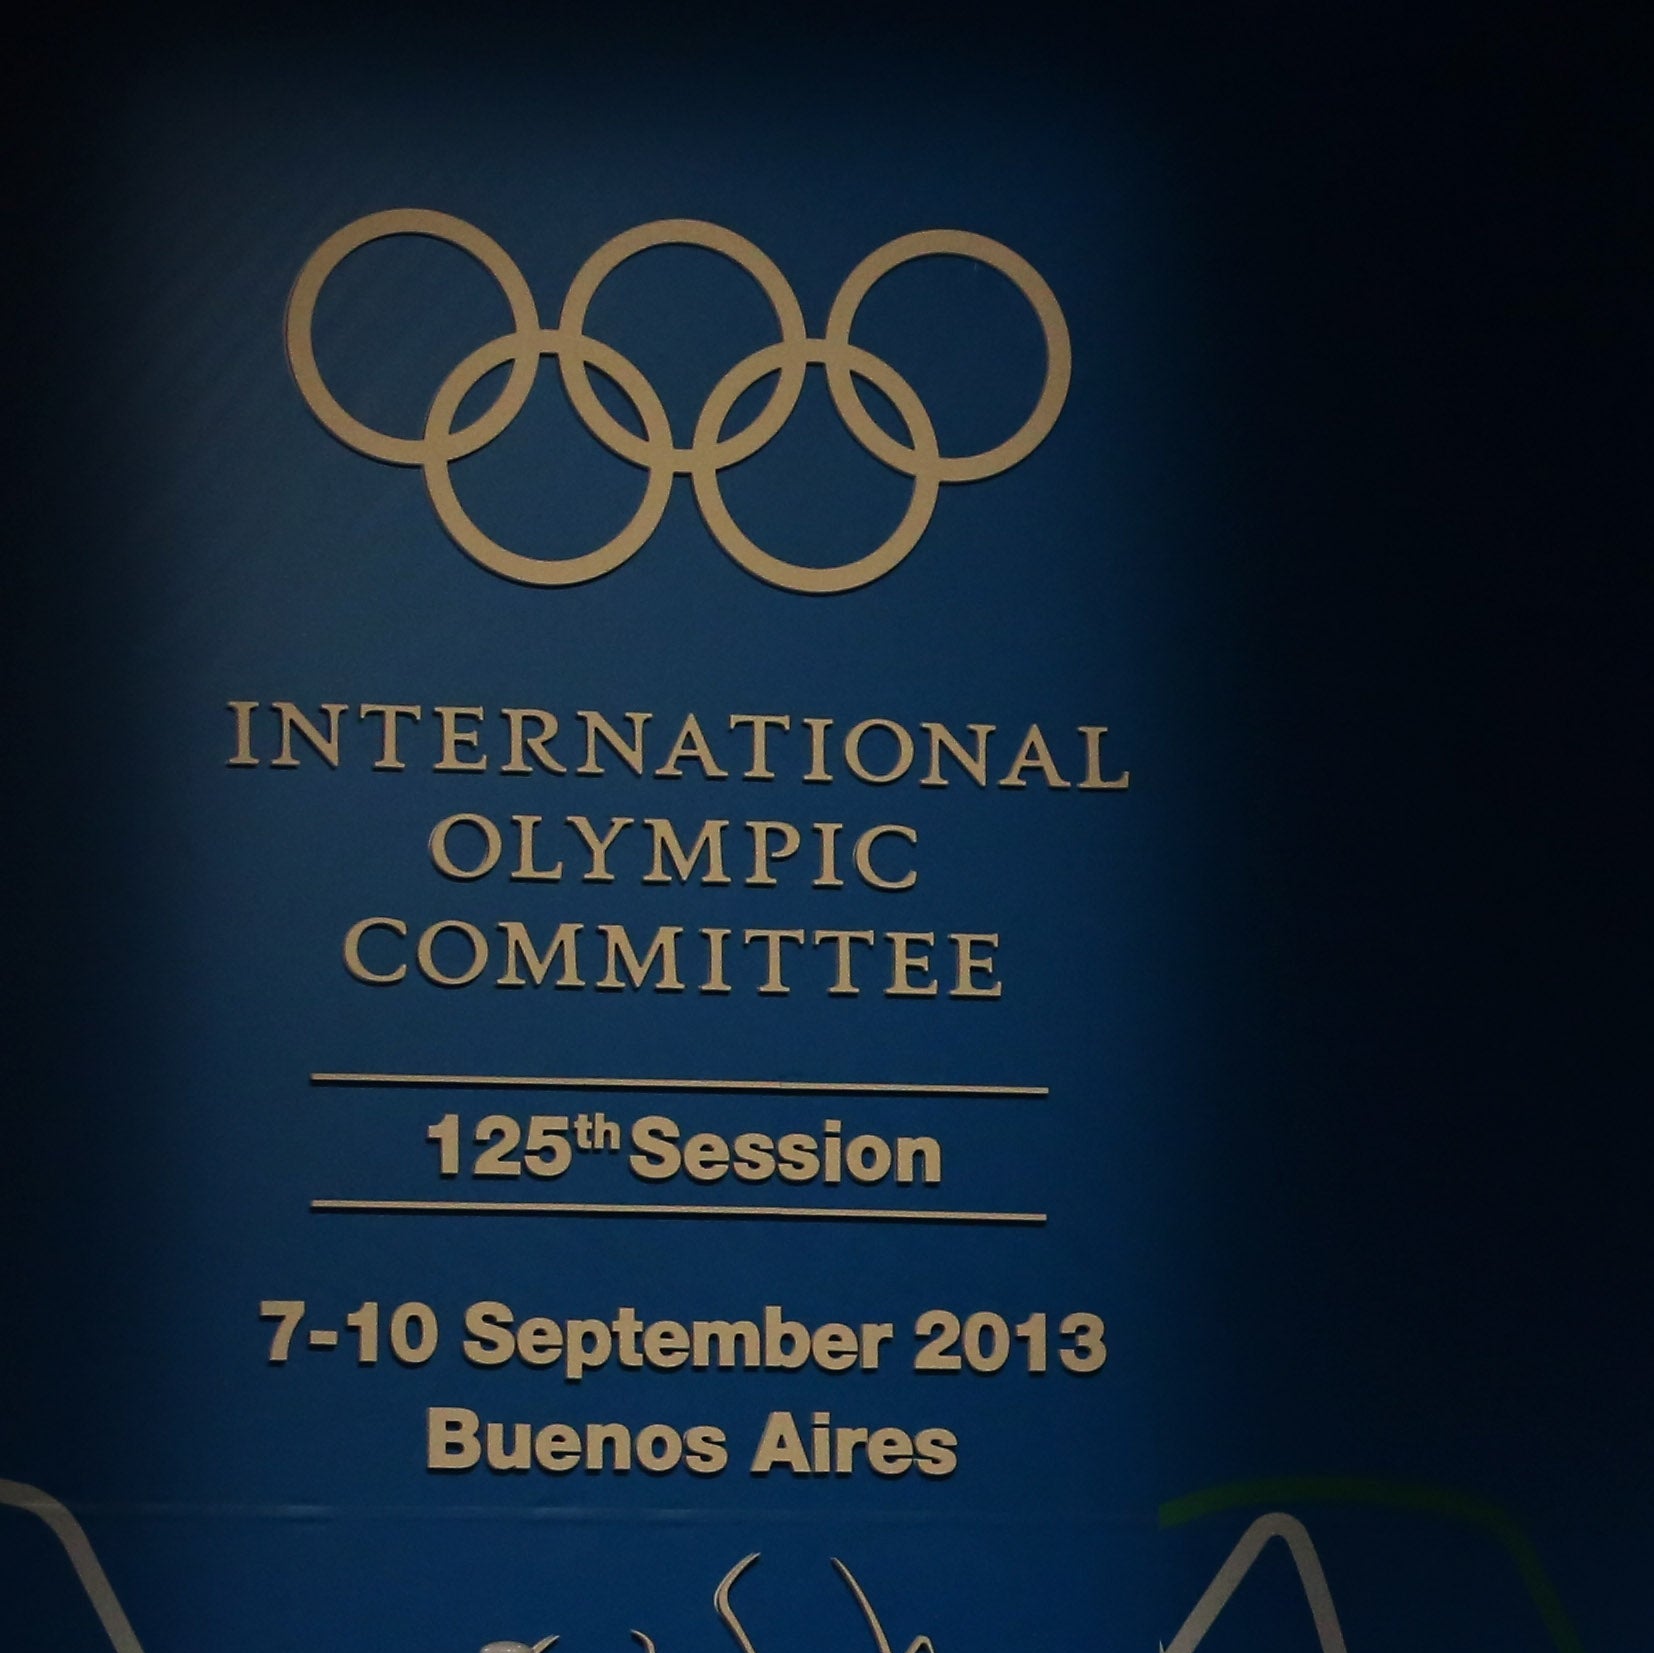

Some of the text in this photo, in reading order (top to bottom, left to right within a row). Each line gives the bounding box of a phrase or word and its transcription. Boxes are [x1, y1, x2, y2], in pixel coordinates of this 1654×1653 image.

[226, 700, 1131, 790] INTERNATIONAL
[428, 812, 918, 890] OLYMPIC
[343, 915, 1003, 998] COMMITTEE
[426, 1112, 942, 1184] 125th Session
[260, 1300, 1107, 1381] 7-10 September 2013
[426, 1406, 959, 1477] Buenos Aires
